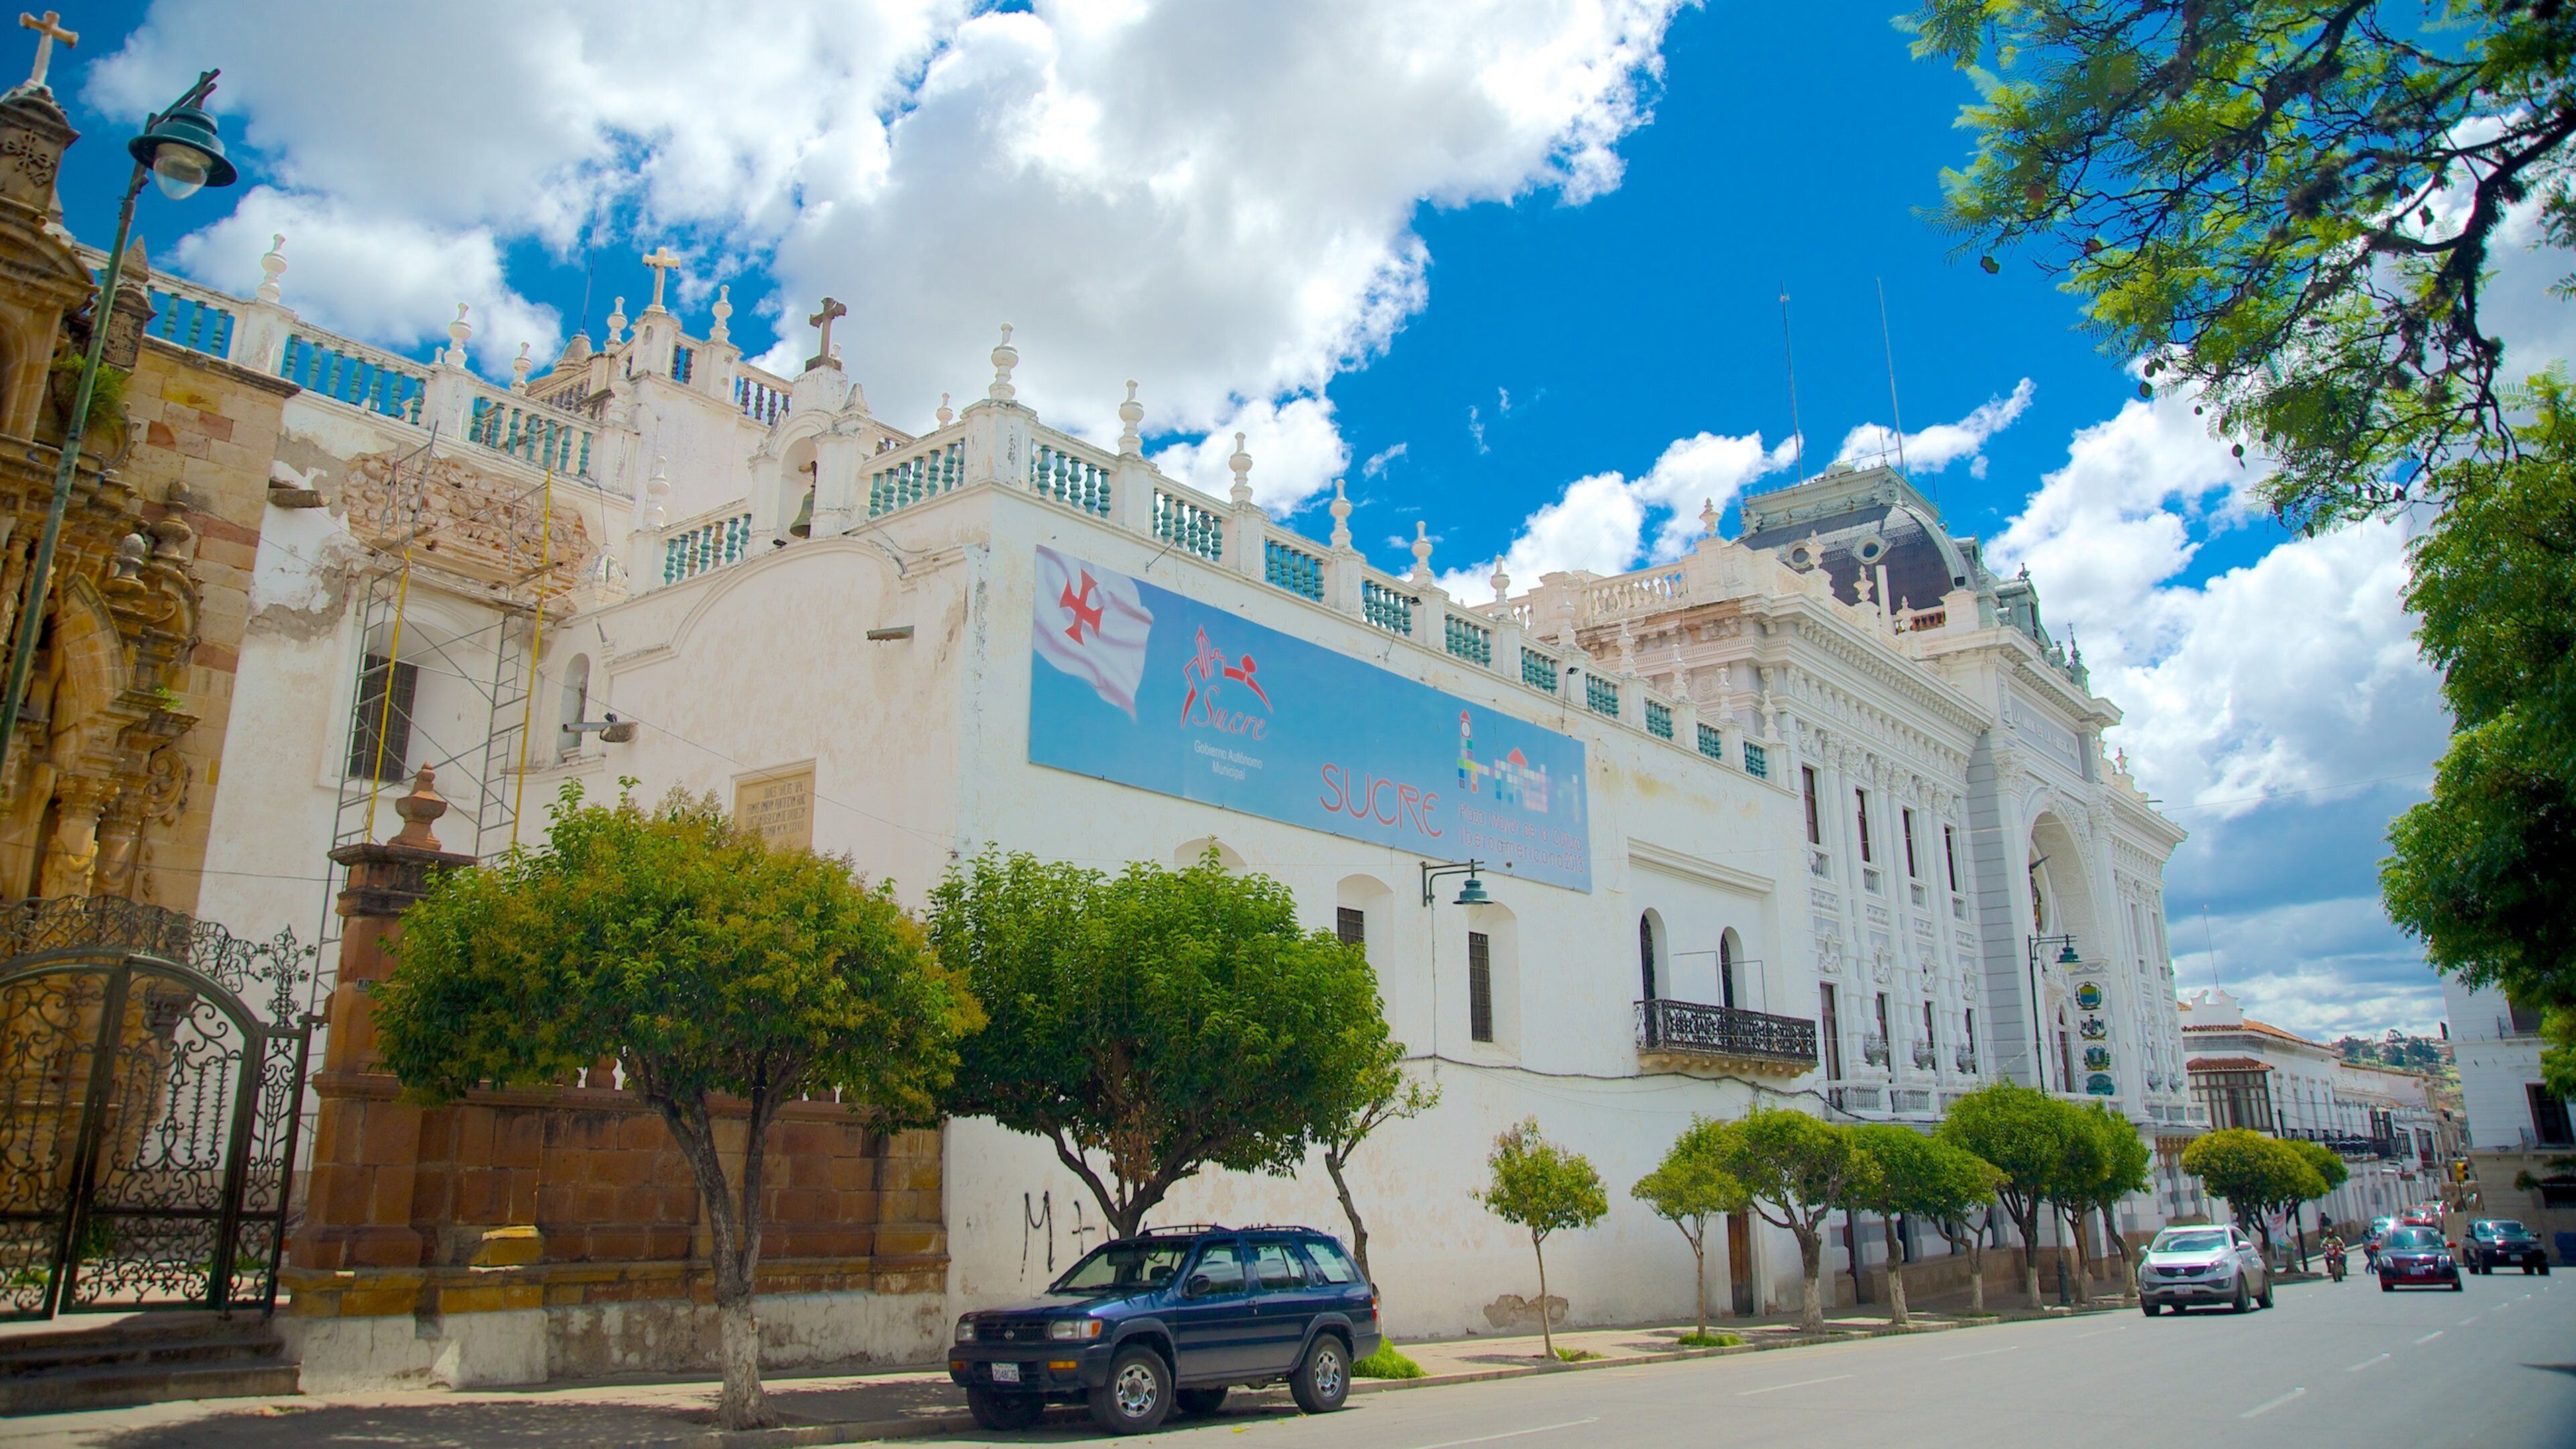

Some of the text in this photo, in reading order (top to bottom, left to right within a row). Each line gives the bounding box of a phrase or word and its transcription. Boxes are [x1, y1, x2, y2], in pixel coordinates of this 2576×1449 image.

[1193, 685, 1269, 740] Sucre
[1194, 739, 1263, 769] Gobierno Autónomo
[1212, 760, 1246, 781] Municipal
[1320, 763, 1443, 838] SUCRE
[1459, 802, 1582, 851] Plaza Mayor de la Cultura
